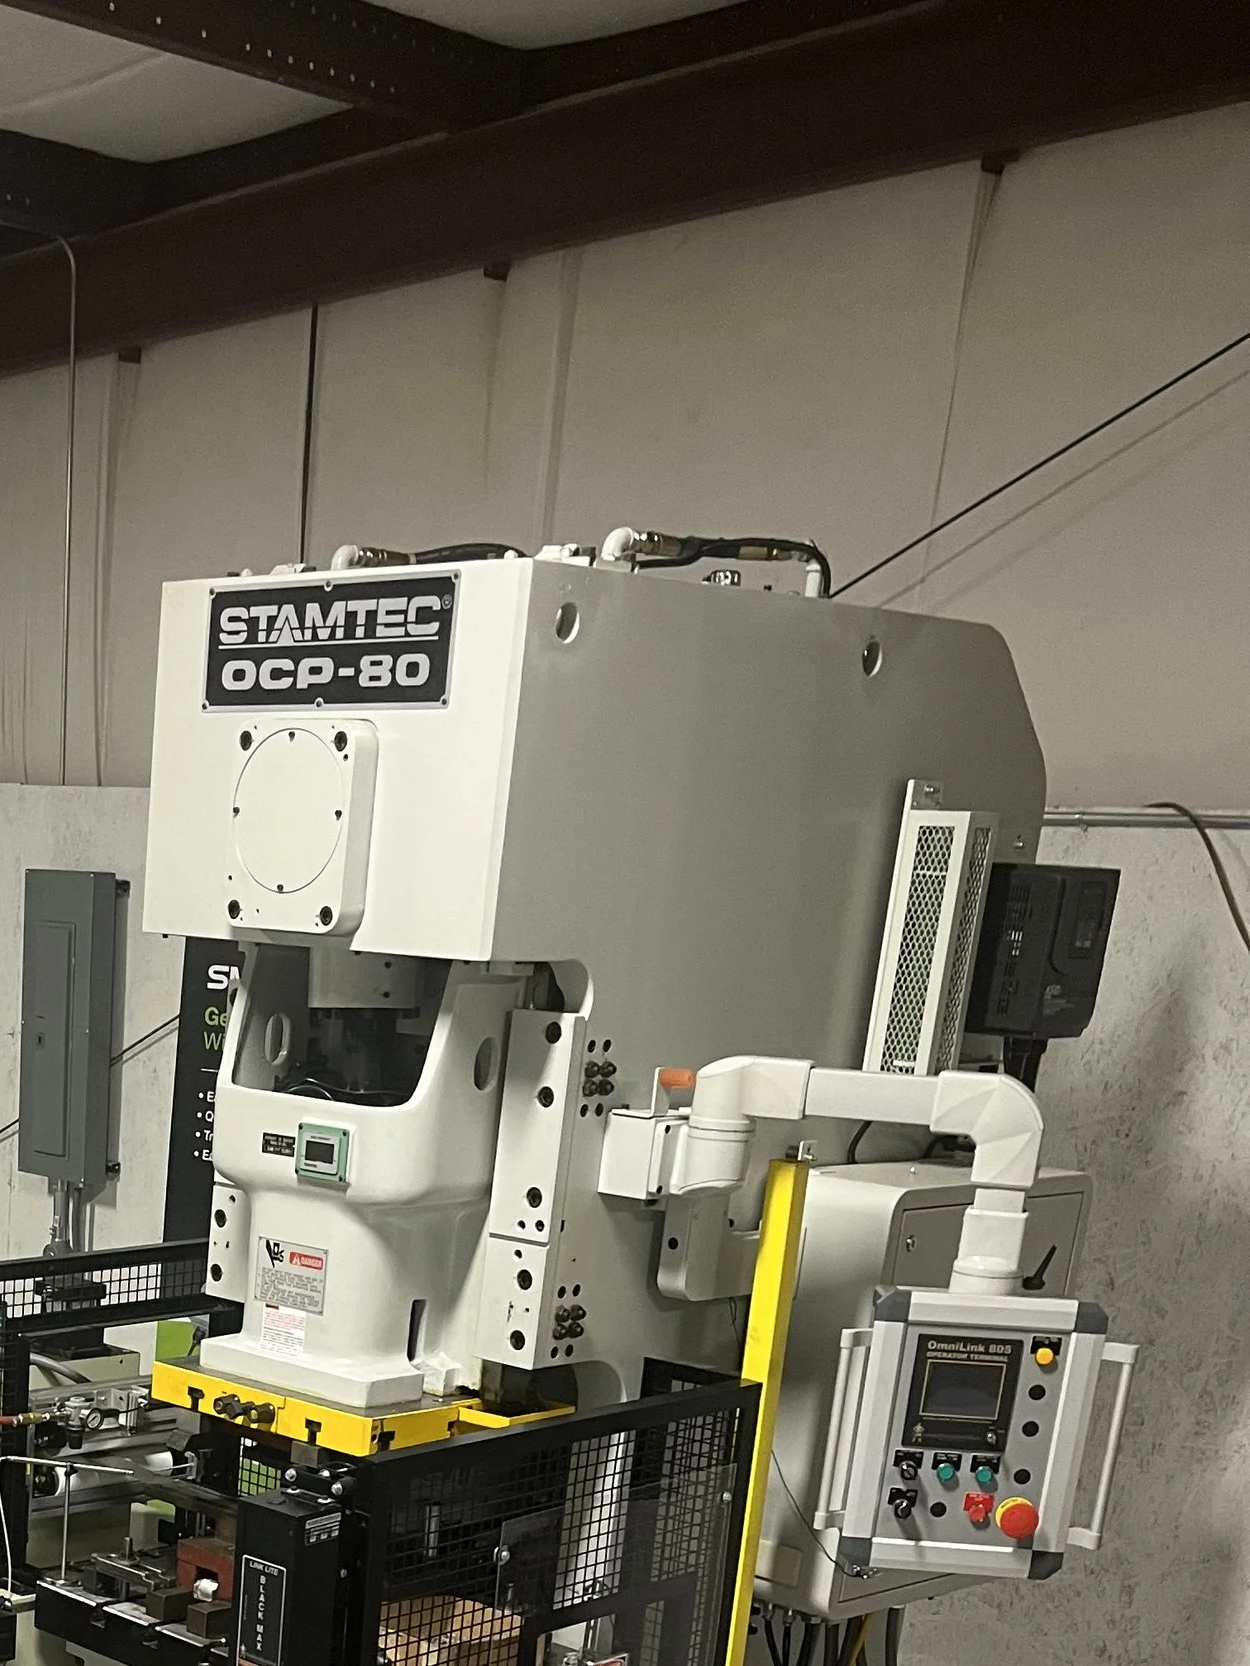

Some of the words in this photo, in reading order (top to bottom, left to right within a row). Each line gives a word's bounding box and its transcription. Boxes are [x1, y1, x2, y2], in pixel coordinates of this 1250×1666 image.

[221, 653, 430, 691] OCP-80
[926, 1351, 968, 1359] OPERATOR
[927, 1340, 985, 1352] OmniLink
[989, 1344, 1011, 1354] 805
[249, 1561, 264, 1571] LINK
[265, 1565, 279, 1576] LITE
[257, 1575, 266, 1620] BLACK
[256, 1624, 264, 1651] MAX
